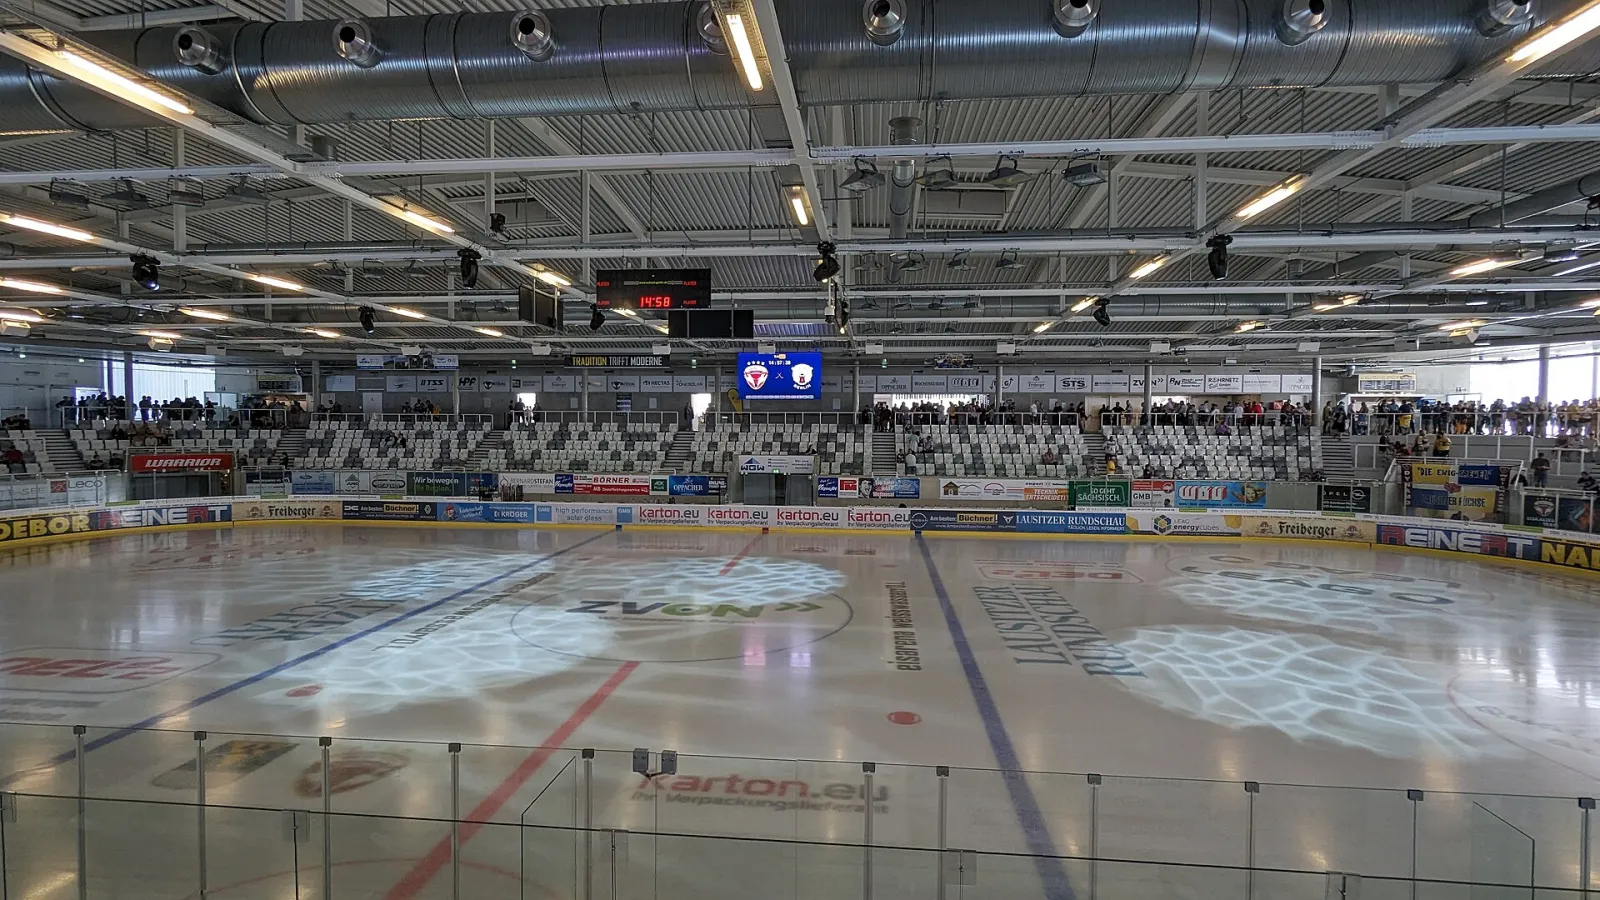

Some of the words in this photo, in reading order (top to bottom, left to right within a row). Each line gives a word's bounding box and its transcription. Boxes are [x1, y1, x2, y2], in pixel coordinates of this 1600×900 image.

[640, 296, 671, 308] 14:58
[572, 356, 608, 366] TRADITION
[609, 356, 629, 366] TRIFFT
[630, 356, 663, 366] MODERNE
[1062, 380, 1085, 388] STS
[1132, 379, 1157, 387] ZVN
[145, 457, 222, 468] WARRIOR
[413, 476, 426, 484] Wir
[426, 476, 459, 485] bewegen
[267, 505, 316, 518] Freiberger
[501, 510, 528, 518] KRÖGER
[555, 507, 570, 515] high
[571, 507, 614, 515] performance
[639, 507, 700, 518] karton.eu
[708, 507, 769, 520] karton.eu
[777, 508, 839, 521] karton.eu
[847, 509, 910, 522] karton.eu
[1016, 514, 1066, 525] LAUSITZER
[1067, 515, 1126, 526] RUNDSCHAU
[1277, 521, 1337, 537] Freiberger
[565, 600, 765, 618] ZVON
[973, 586, 1072, 666] LAUSITZER
[1013, 583, 1148, 679] RUNDSCHAU
[637, 773, 890, 802] karton.eu
